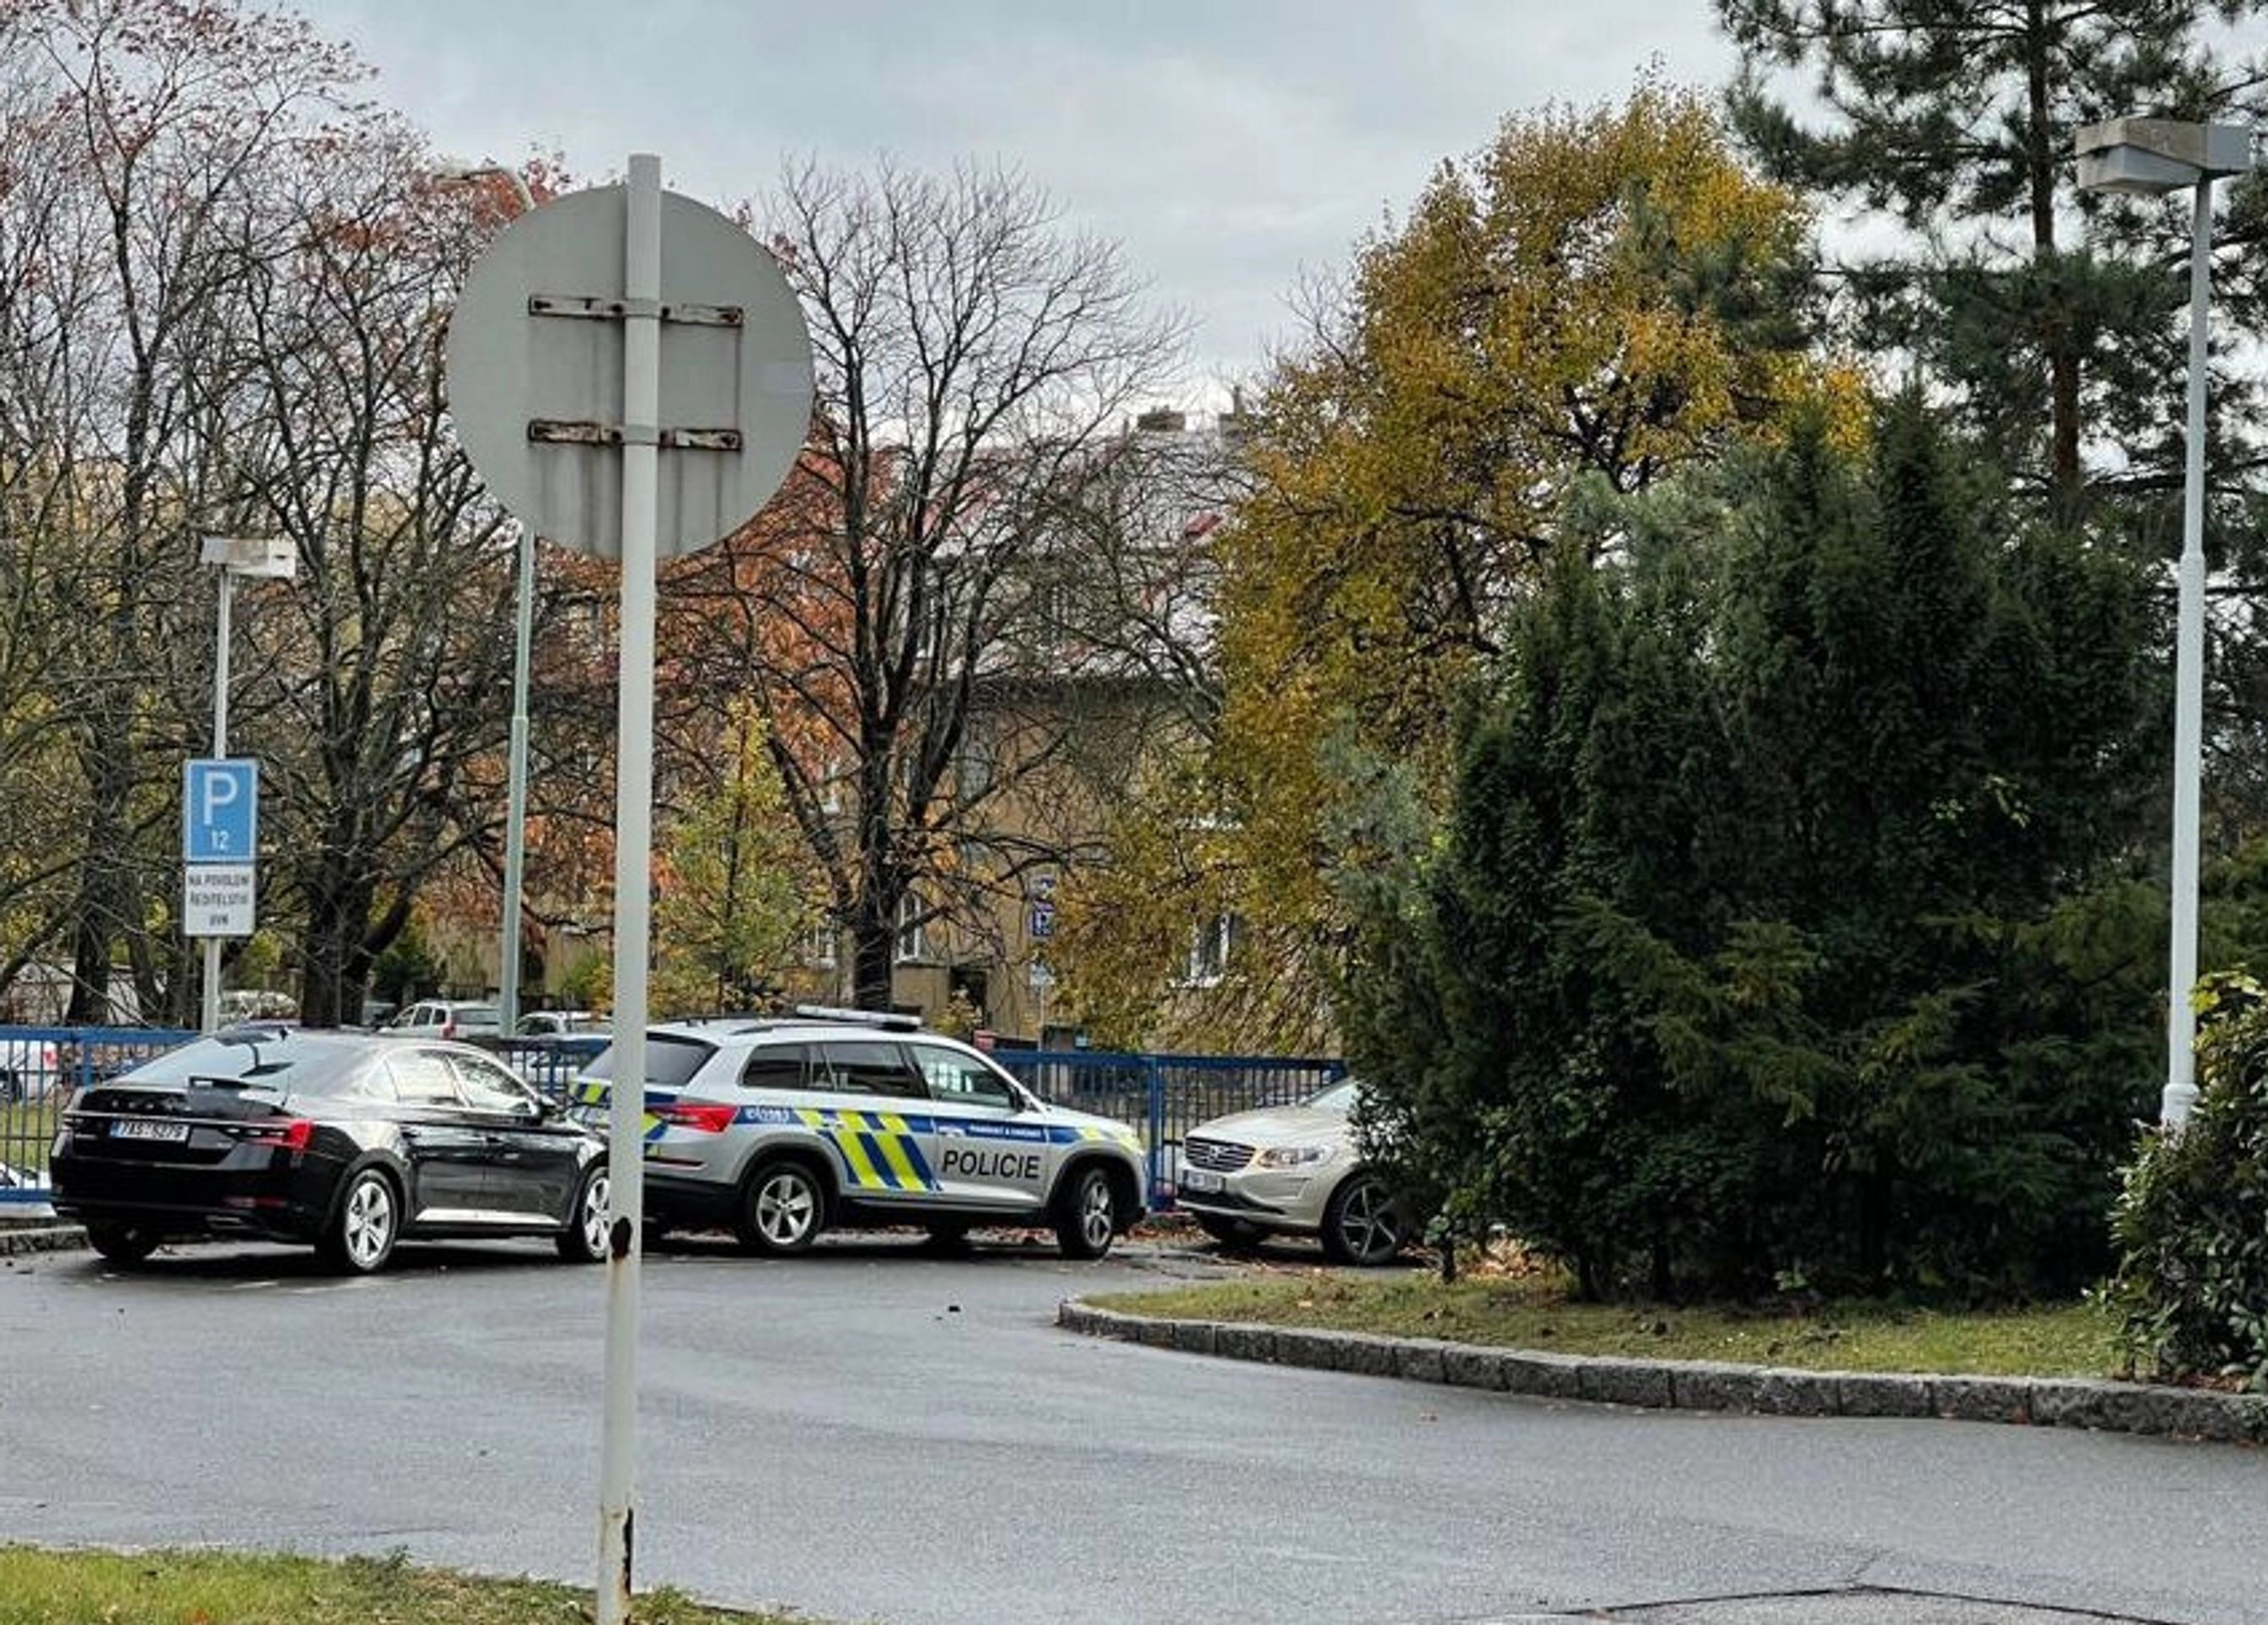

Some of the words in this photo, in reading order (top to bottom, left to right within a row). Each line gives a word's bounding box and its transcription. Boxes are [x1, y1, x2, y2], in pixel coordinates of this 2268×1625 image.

[203, 771, 239, 825] P
[212, 830, 229, 850] 12
[941, 1150, 1041, 1179] POLICIE
